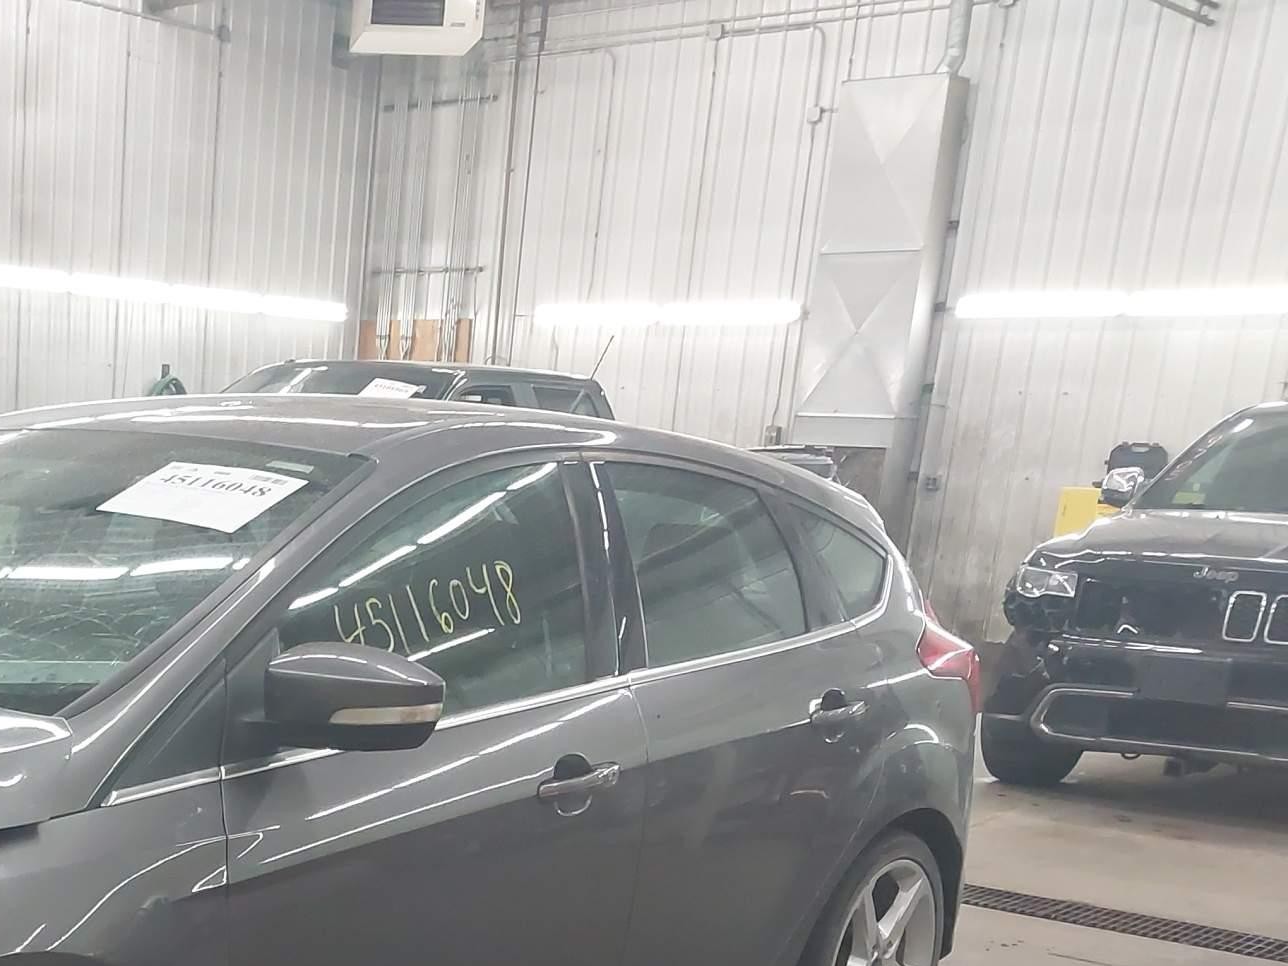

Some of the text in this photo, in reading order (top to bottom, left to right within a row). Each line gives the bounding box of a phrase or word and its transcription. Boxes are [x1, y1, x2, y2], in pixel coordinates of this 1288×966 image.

[160, 474, 272, 497] 45116048
[1192, 566, 1240, 584] Jeep
[334, 560, 521, 654] 45116048
